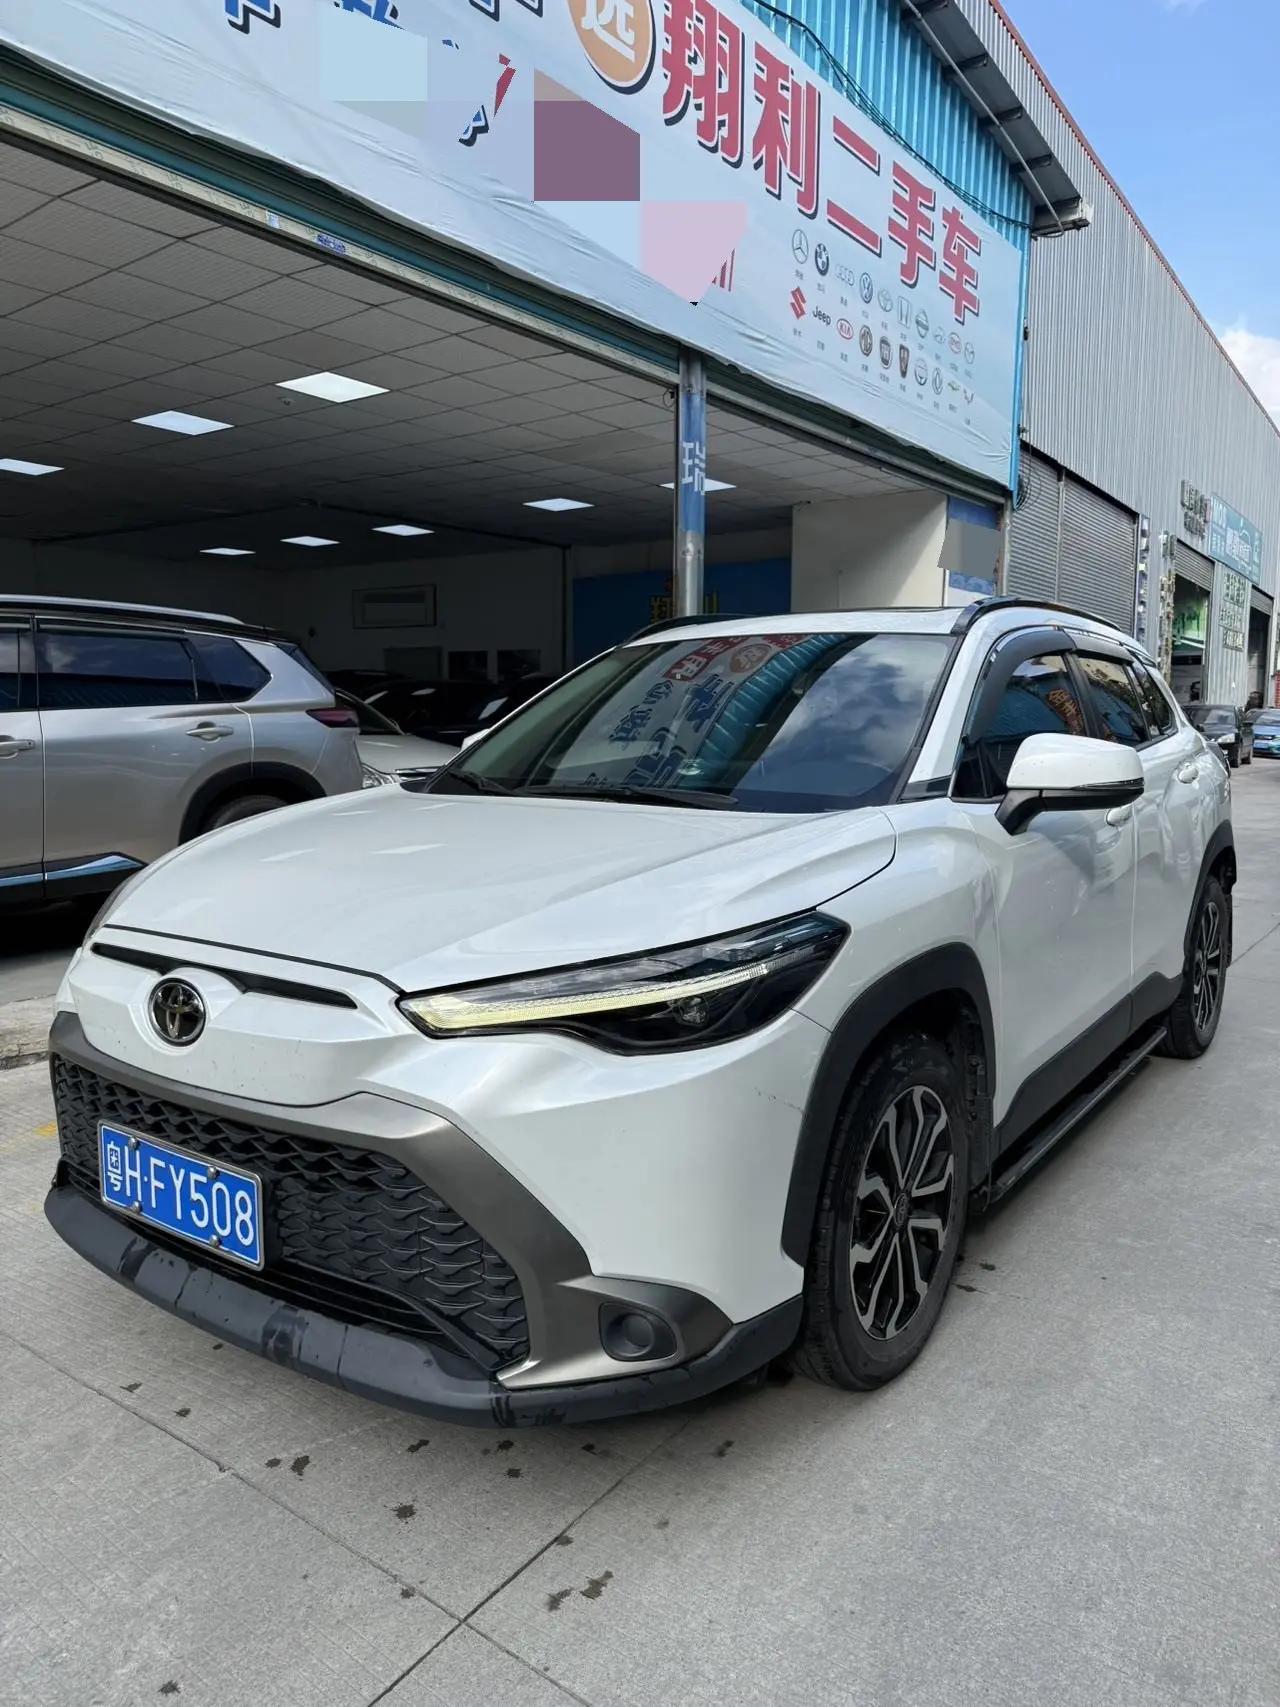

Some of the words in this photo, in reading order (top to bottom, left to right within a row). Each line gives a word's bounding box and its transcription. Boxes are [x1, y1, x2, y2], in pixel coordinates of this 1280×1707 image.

[662, 0, 982, 325] 翔利二手车
[812, 306, 832, 325] Jeep
